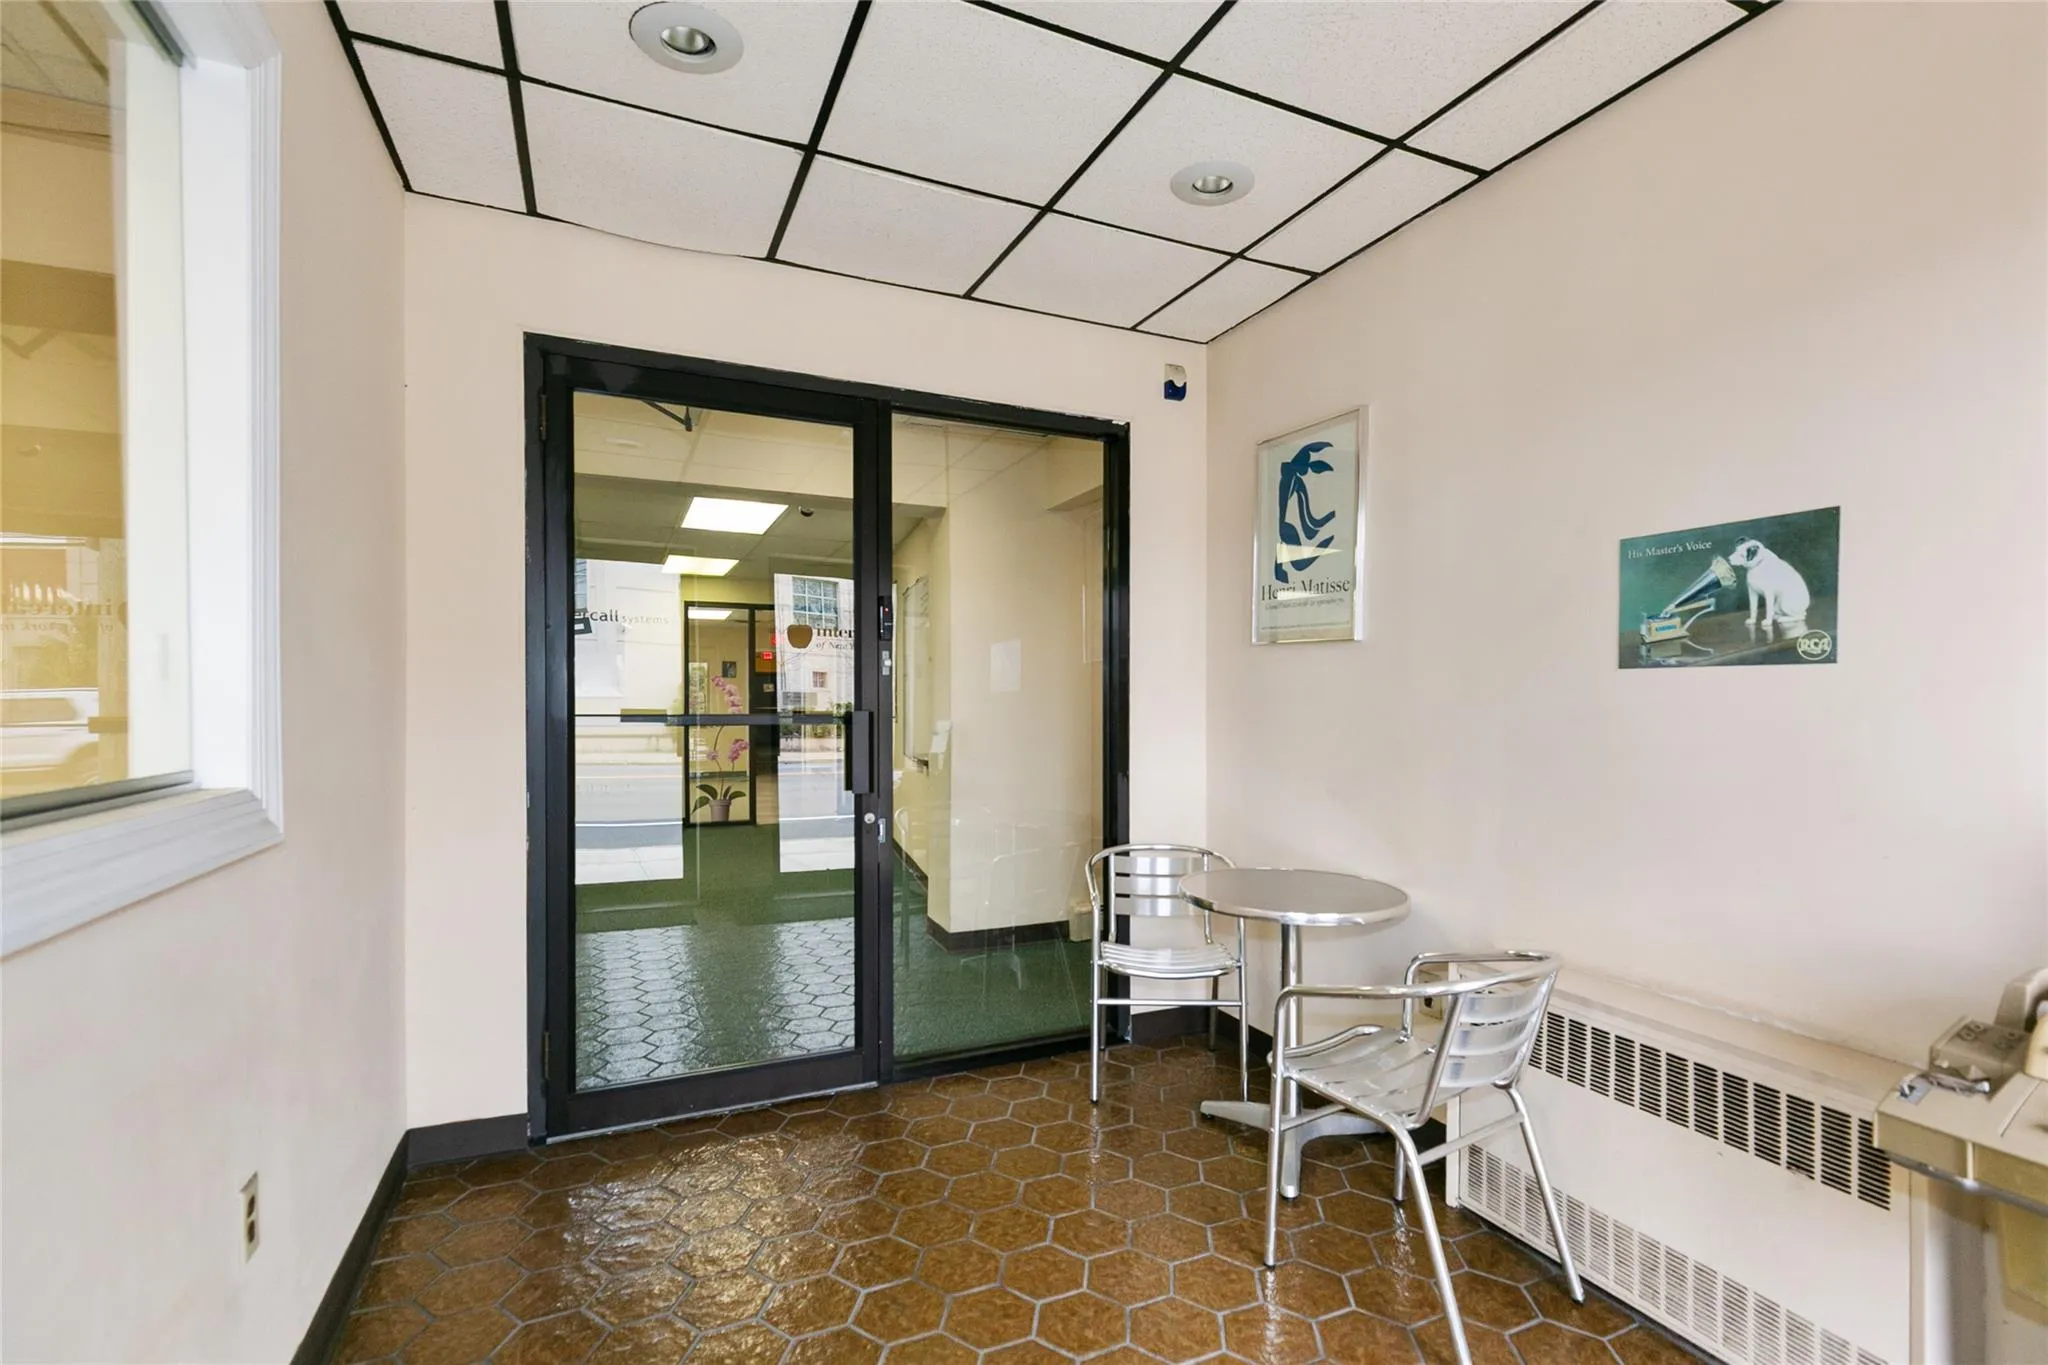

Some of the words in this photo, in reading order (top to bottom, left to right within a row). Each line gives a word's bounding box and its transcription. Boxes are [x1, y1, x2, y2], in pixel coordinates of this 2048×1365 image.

[1646, 543, 1684, 557] Master's
[1686, 541, 1712, 551] Voice
[1301, 577, 1351, 596] Matisse
[621, 614, 669, 626] systems
